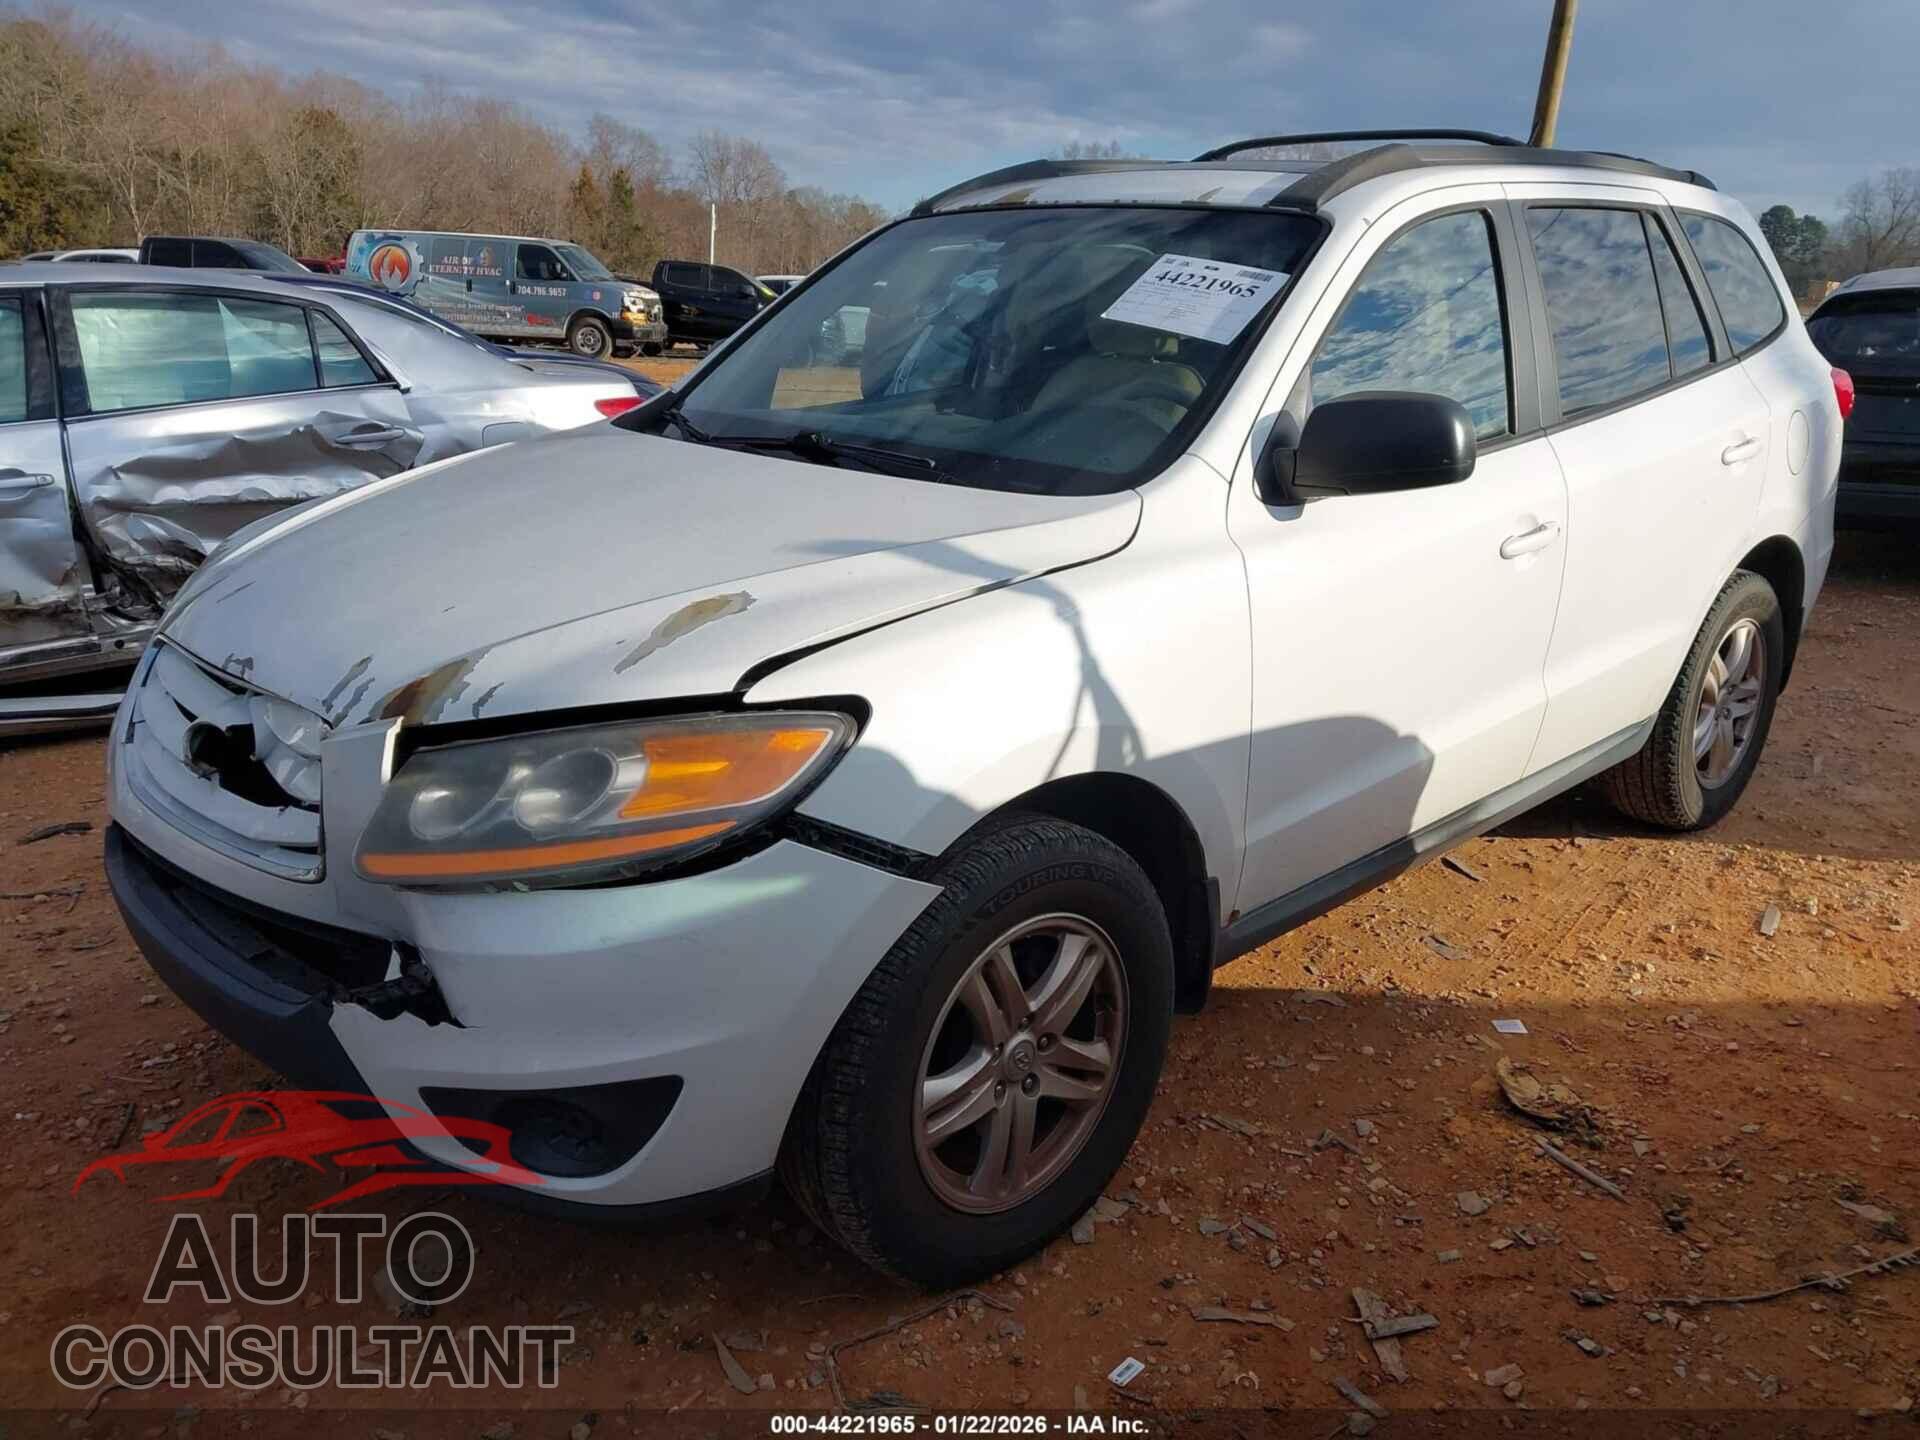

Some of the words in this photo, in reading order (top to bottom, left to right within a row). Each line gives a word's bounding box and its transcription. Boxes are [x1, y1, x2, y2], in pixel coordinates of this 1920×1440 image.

[442, 255, 458, 265] AIR
[462, 255, 473, 265] OF
[475, 266, 503, 276] HVAC
[1154, 270, 1261, 298] 44221965
[984, 863, 1085, 912] TOURING
